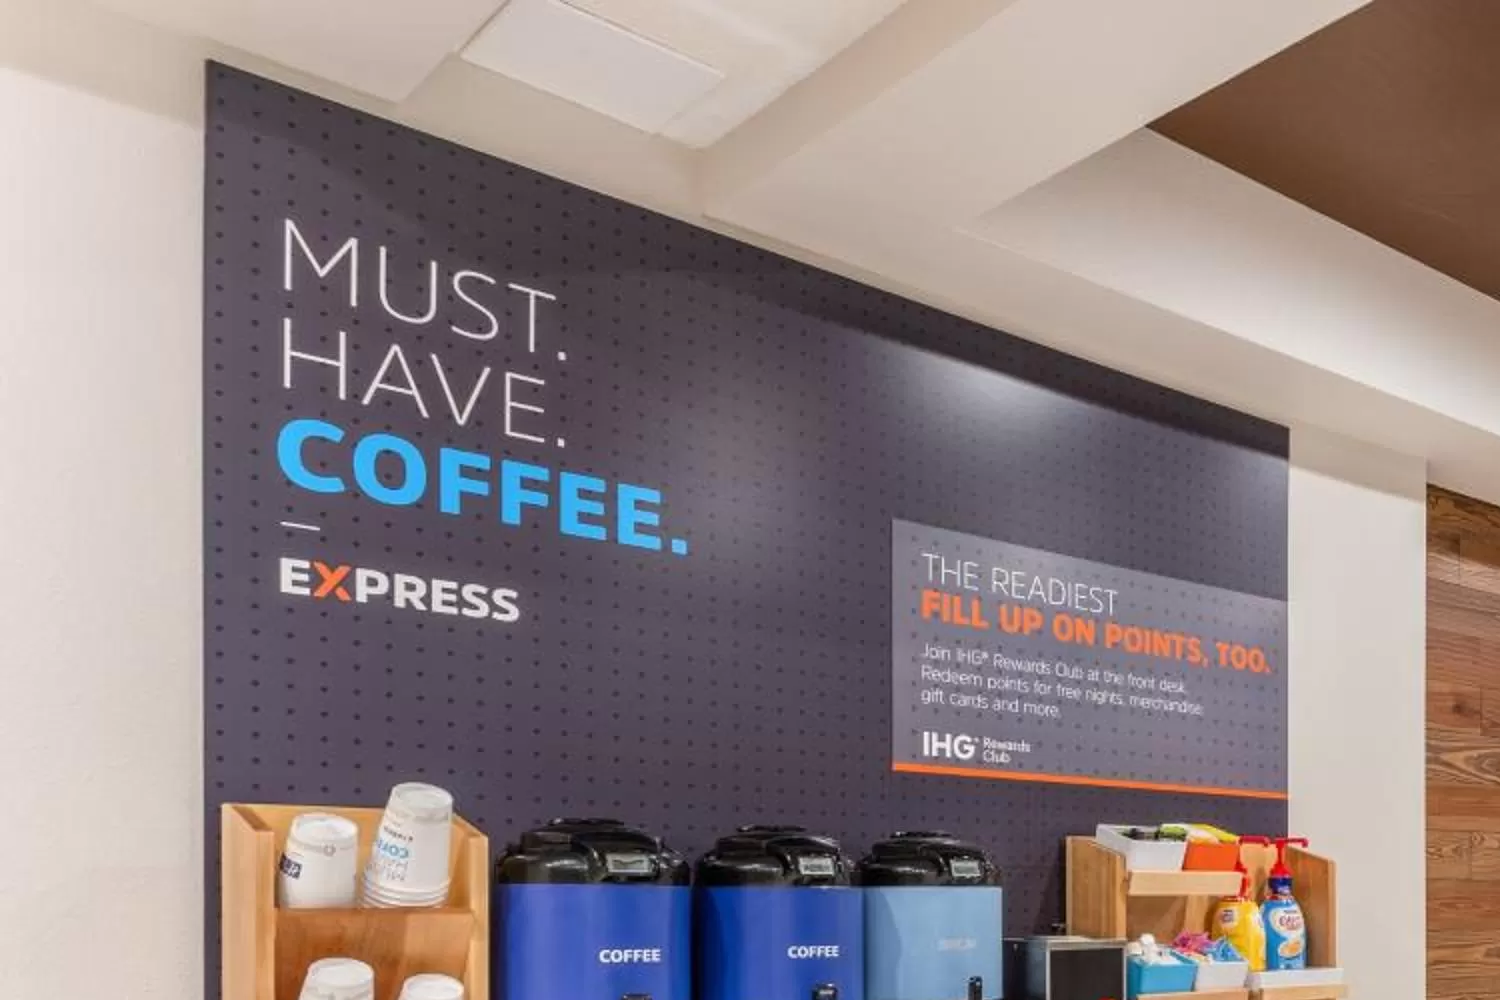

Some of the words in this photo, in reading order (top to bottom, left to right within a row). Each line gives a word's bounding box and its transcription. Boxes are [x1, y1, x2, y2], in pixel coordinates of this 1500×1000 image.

[284, 217, 567, 361] MUST.
[283, 317, 566, 448] HAVE.
[276, 418, 688, 555] COFFEE.
[280, 556, 520, 622] EXPRESS
[921, 552, 979, 592] THE
[990, 566, 1118, 616] READIEST
[920, 588, 989, 630] FILL
[999, 603, 1044, 636] UP
[1051, 613, 1097, 647] ON
[1104, 622, 1209, 668] POINTS,
[1215, 641, 1273, 674] TOO.
[919, 643, 951, 661] Join
[993, 653, 1051, 675] Rewards
[1087, 668, 1100, 682] at
[1103, 670, 1125, 685] the
[1127, 671, 1156, 690] front
[920, 664, 983, 687] Redeem
[987, 675, 1030, 695] points
[1033, 680, 1052, 696] for
[1056, 684, 1082, 700] free
[920, 687, 945, 705] gift
[949, 692, 989, 709] cards
[992, 698, 1019, 713] and
[982, 750, 1011, 764] Club
[599, 948, 662, 963] COFFEE
[787, 945, 840, 959] COFFEE
